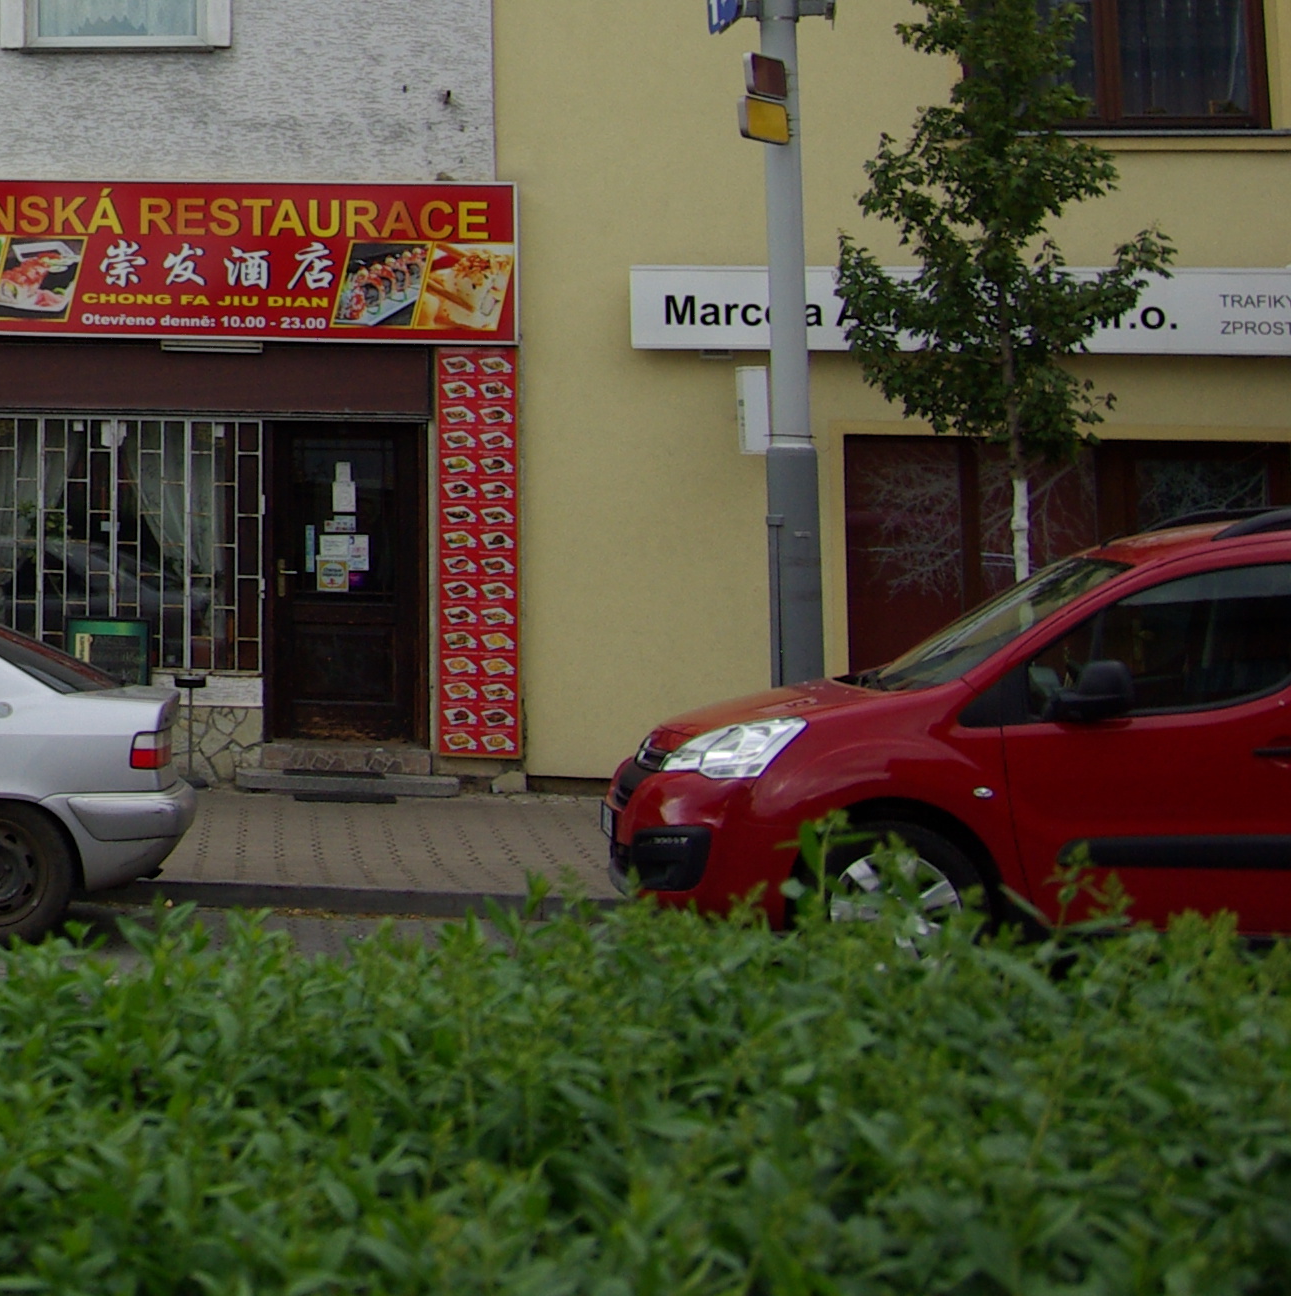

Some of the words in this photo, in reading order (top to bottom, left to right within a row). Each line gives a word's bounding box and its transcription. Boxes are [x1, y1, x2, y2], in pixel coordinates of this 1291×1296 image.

[139, 197, 490, 240] RESTAURACE
[99, 239, 335, 290] 崇发酒店
[81, 292, 172, 305] CHONG
[181, 294, 210, 306] FA
[217, 296, 259, 307] JIU
[267, 297, 329, 308] DIAN
[664, 294, 823, 327] Marca
[81, 312, 156, 328] Otevřeno
[160, 313, 216, 328] denně:
[221, 315, 266, 329] 10.00
[280, 316, 326, 330] 23.00
